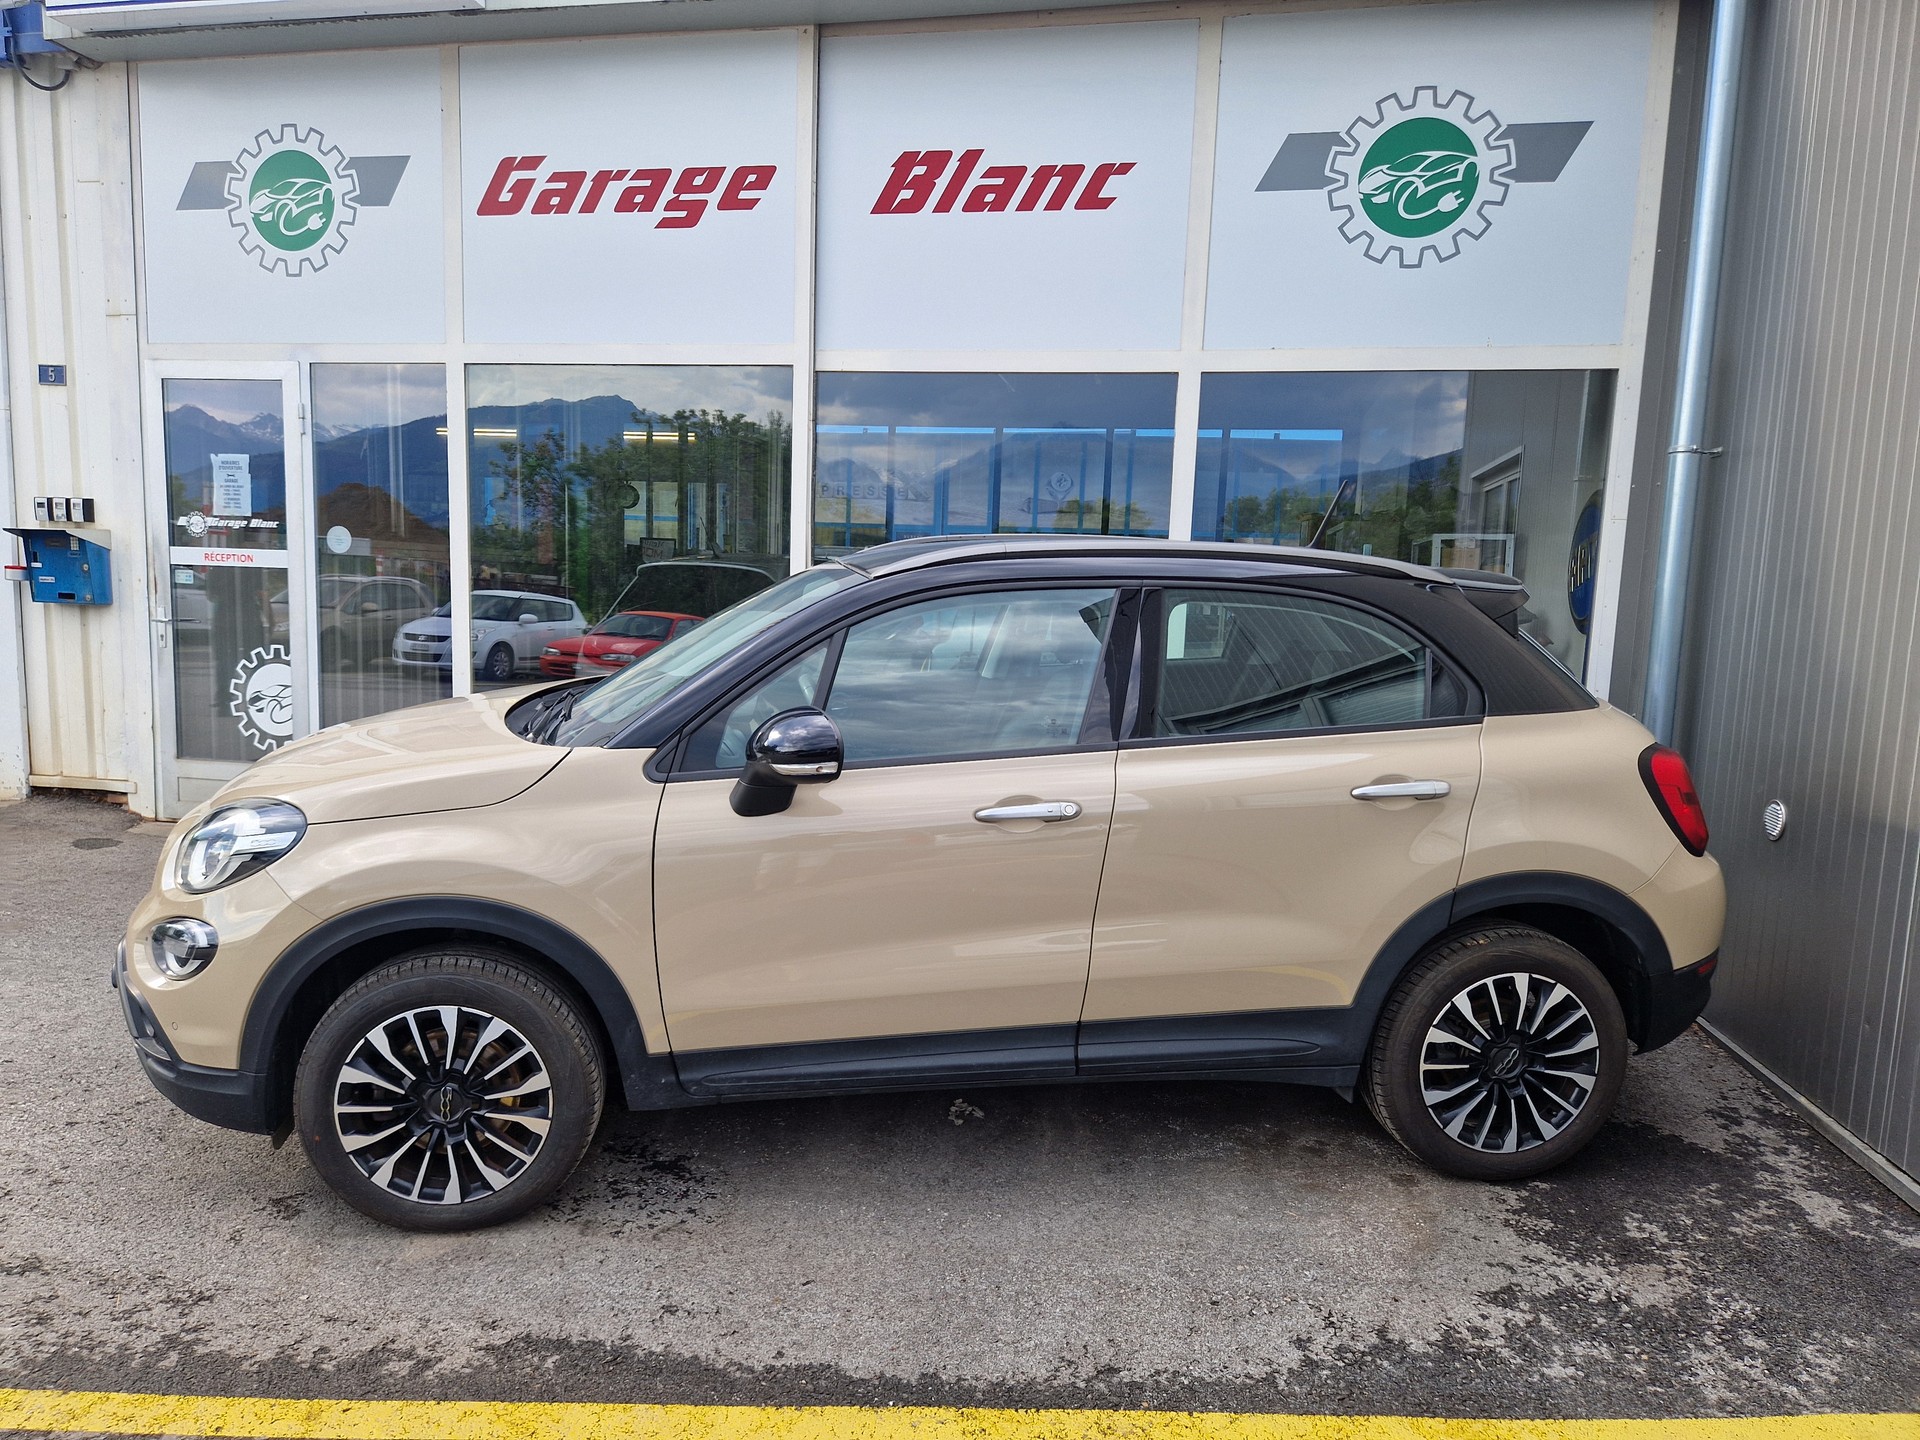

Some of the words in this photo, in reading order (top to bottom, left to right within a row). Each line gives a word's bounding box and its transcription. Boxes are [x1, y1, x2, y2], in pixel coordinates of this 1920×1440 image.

[476, 155, 777, 229] Garage
[869, 148, 1137, 215] Blanc
[48, 367, 55, 382] 5
[210, 517, 248, 529] Garage
[249, 518, 280, 528] Blanc
[204, 550, 254, 563] RÉCEPTION
